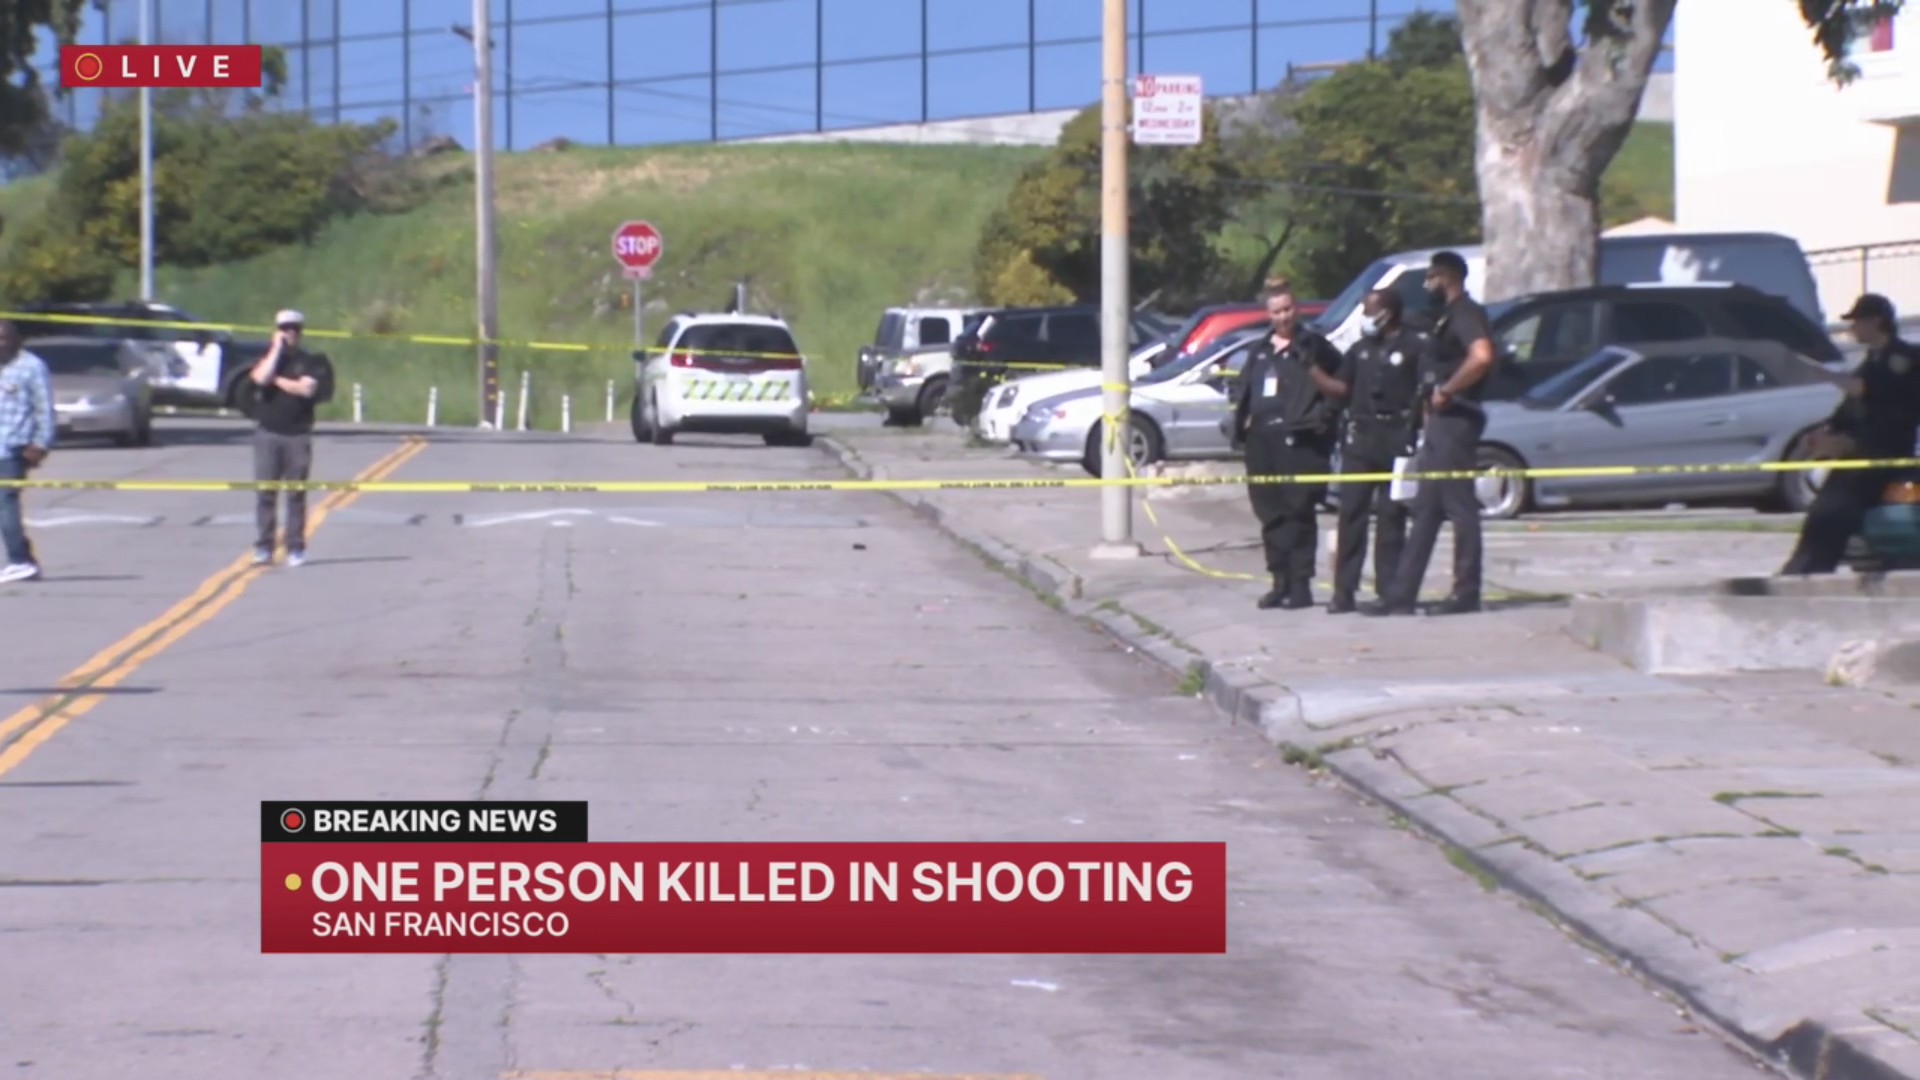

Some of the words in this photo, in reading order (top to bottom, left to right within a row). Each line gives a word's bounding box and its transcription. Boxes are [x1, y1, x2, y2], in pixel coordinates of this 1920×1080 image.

[1156, 83, 1199, 94] PARKING
[1138, 119, 1195, 129] WEDNESDAY
[617, 236, 658, 255] STOP
